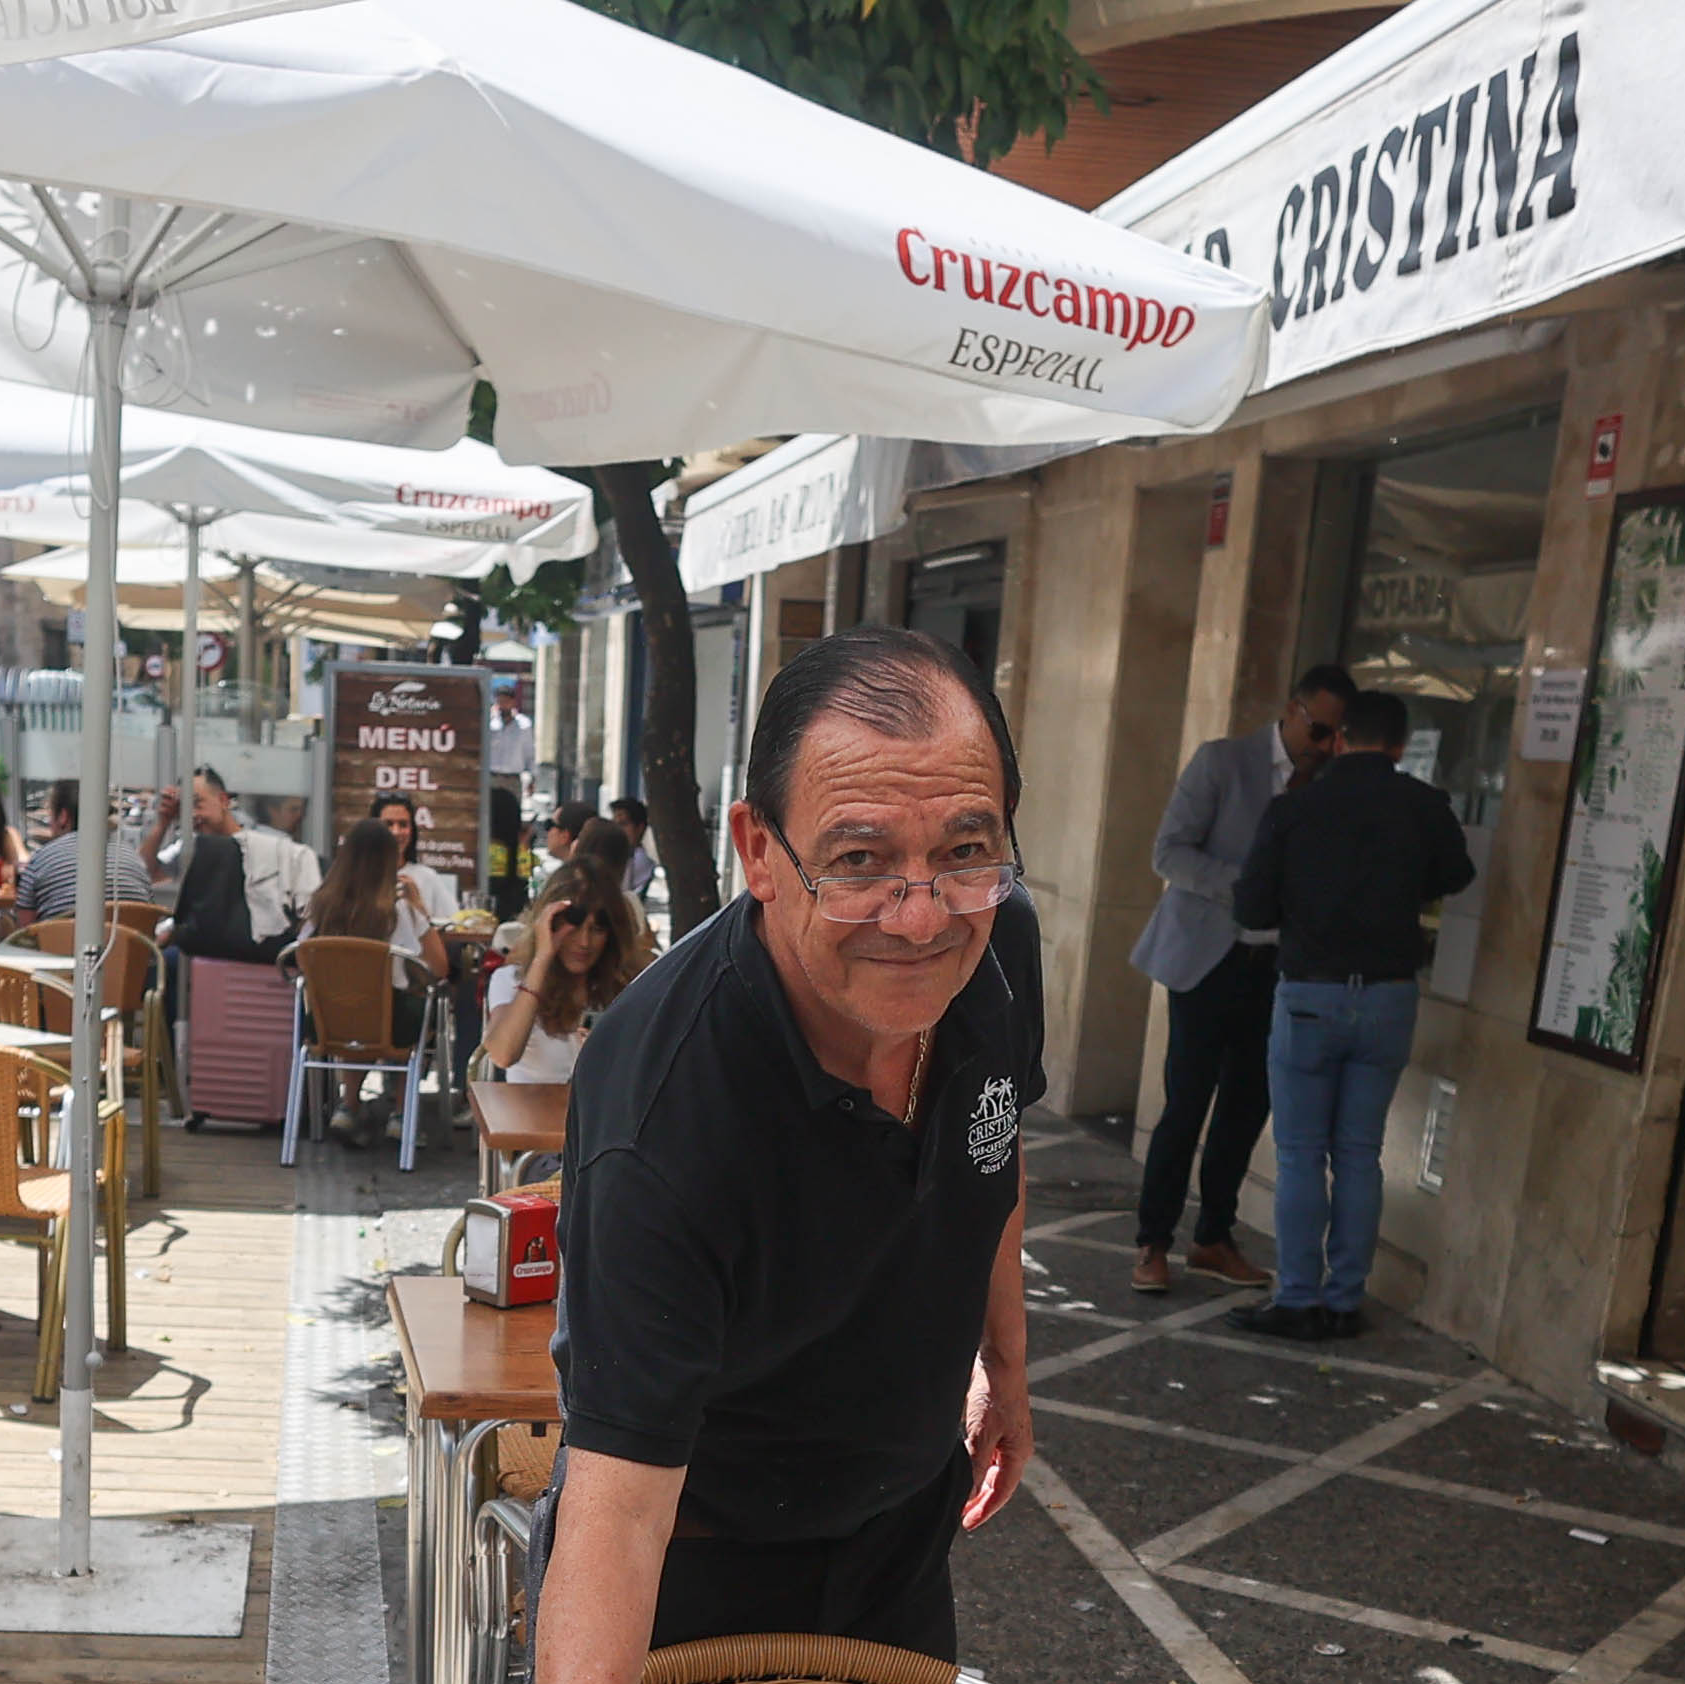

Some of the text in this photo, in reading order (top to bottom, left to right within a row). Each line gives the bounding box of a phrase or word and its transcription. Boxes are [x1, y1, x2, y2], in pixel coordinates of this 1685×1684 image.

[1272, 31, 1580, 332] CRISTINA
[896, 227, 1195, 351] Cruzcampo
[948, 327, 1105, 393] ESPECIAL
[396, 484, 551, 521] Cruzcampo
[358, 724, 456, 753] MENÚ
[375, 766, 438, 791] DEL
